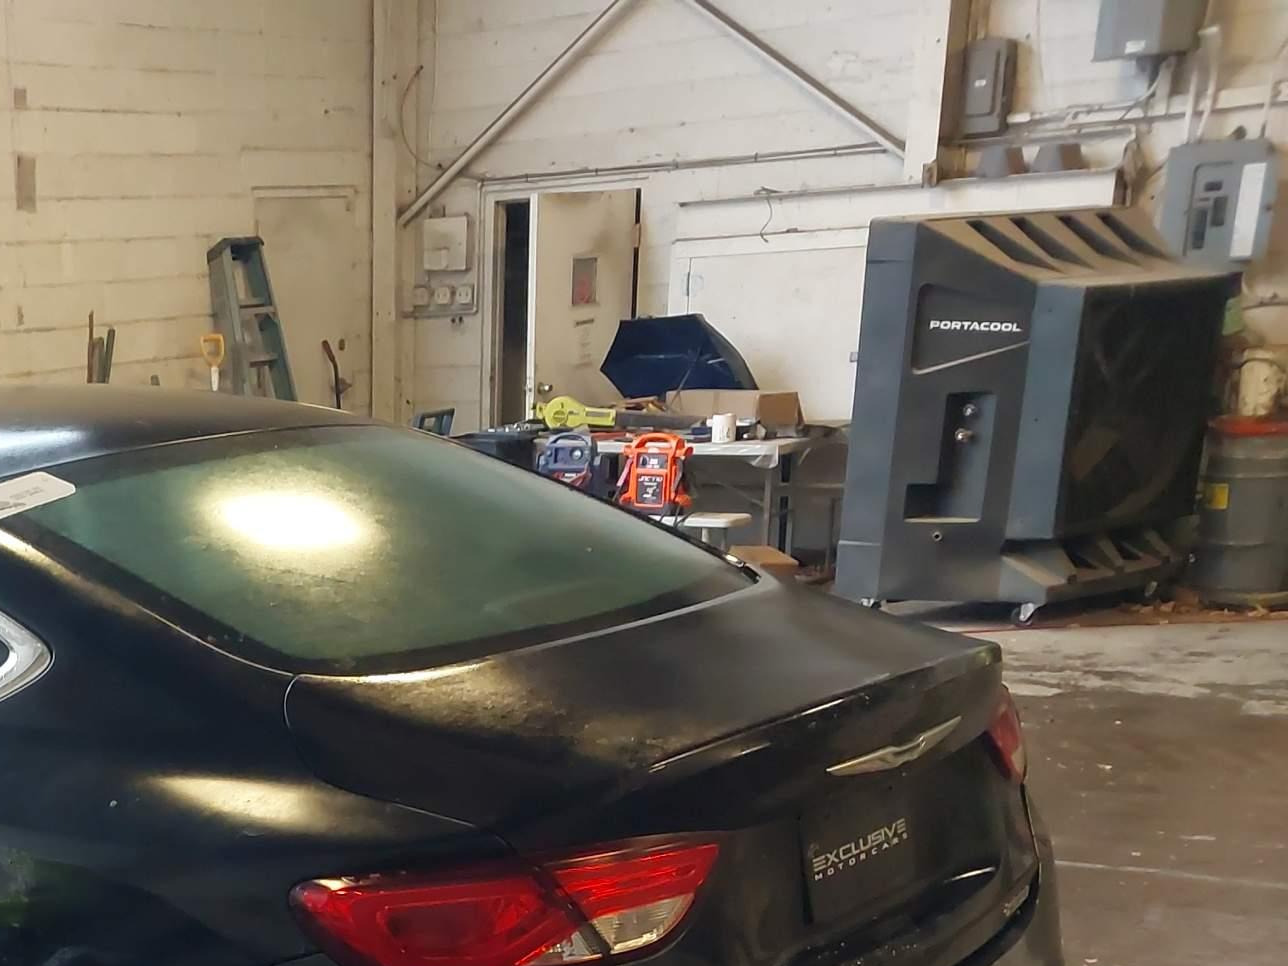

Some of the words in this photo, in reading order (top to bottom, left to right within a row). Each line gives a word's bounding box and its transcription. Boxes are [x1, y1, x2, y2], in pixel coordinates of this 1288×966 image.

[929, 320, 1023, 332] PORTACOOL
[812, 818, 906, 872] EXCLUSIVE
[814, 833, 908, 881] MOTORCARS
